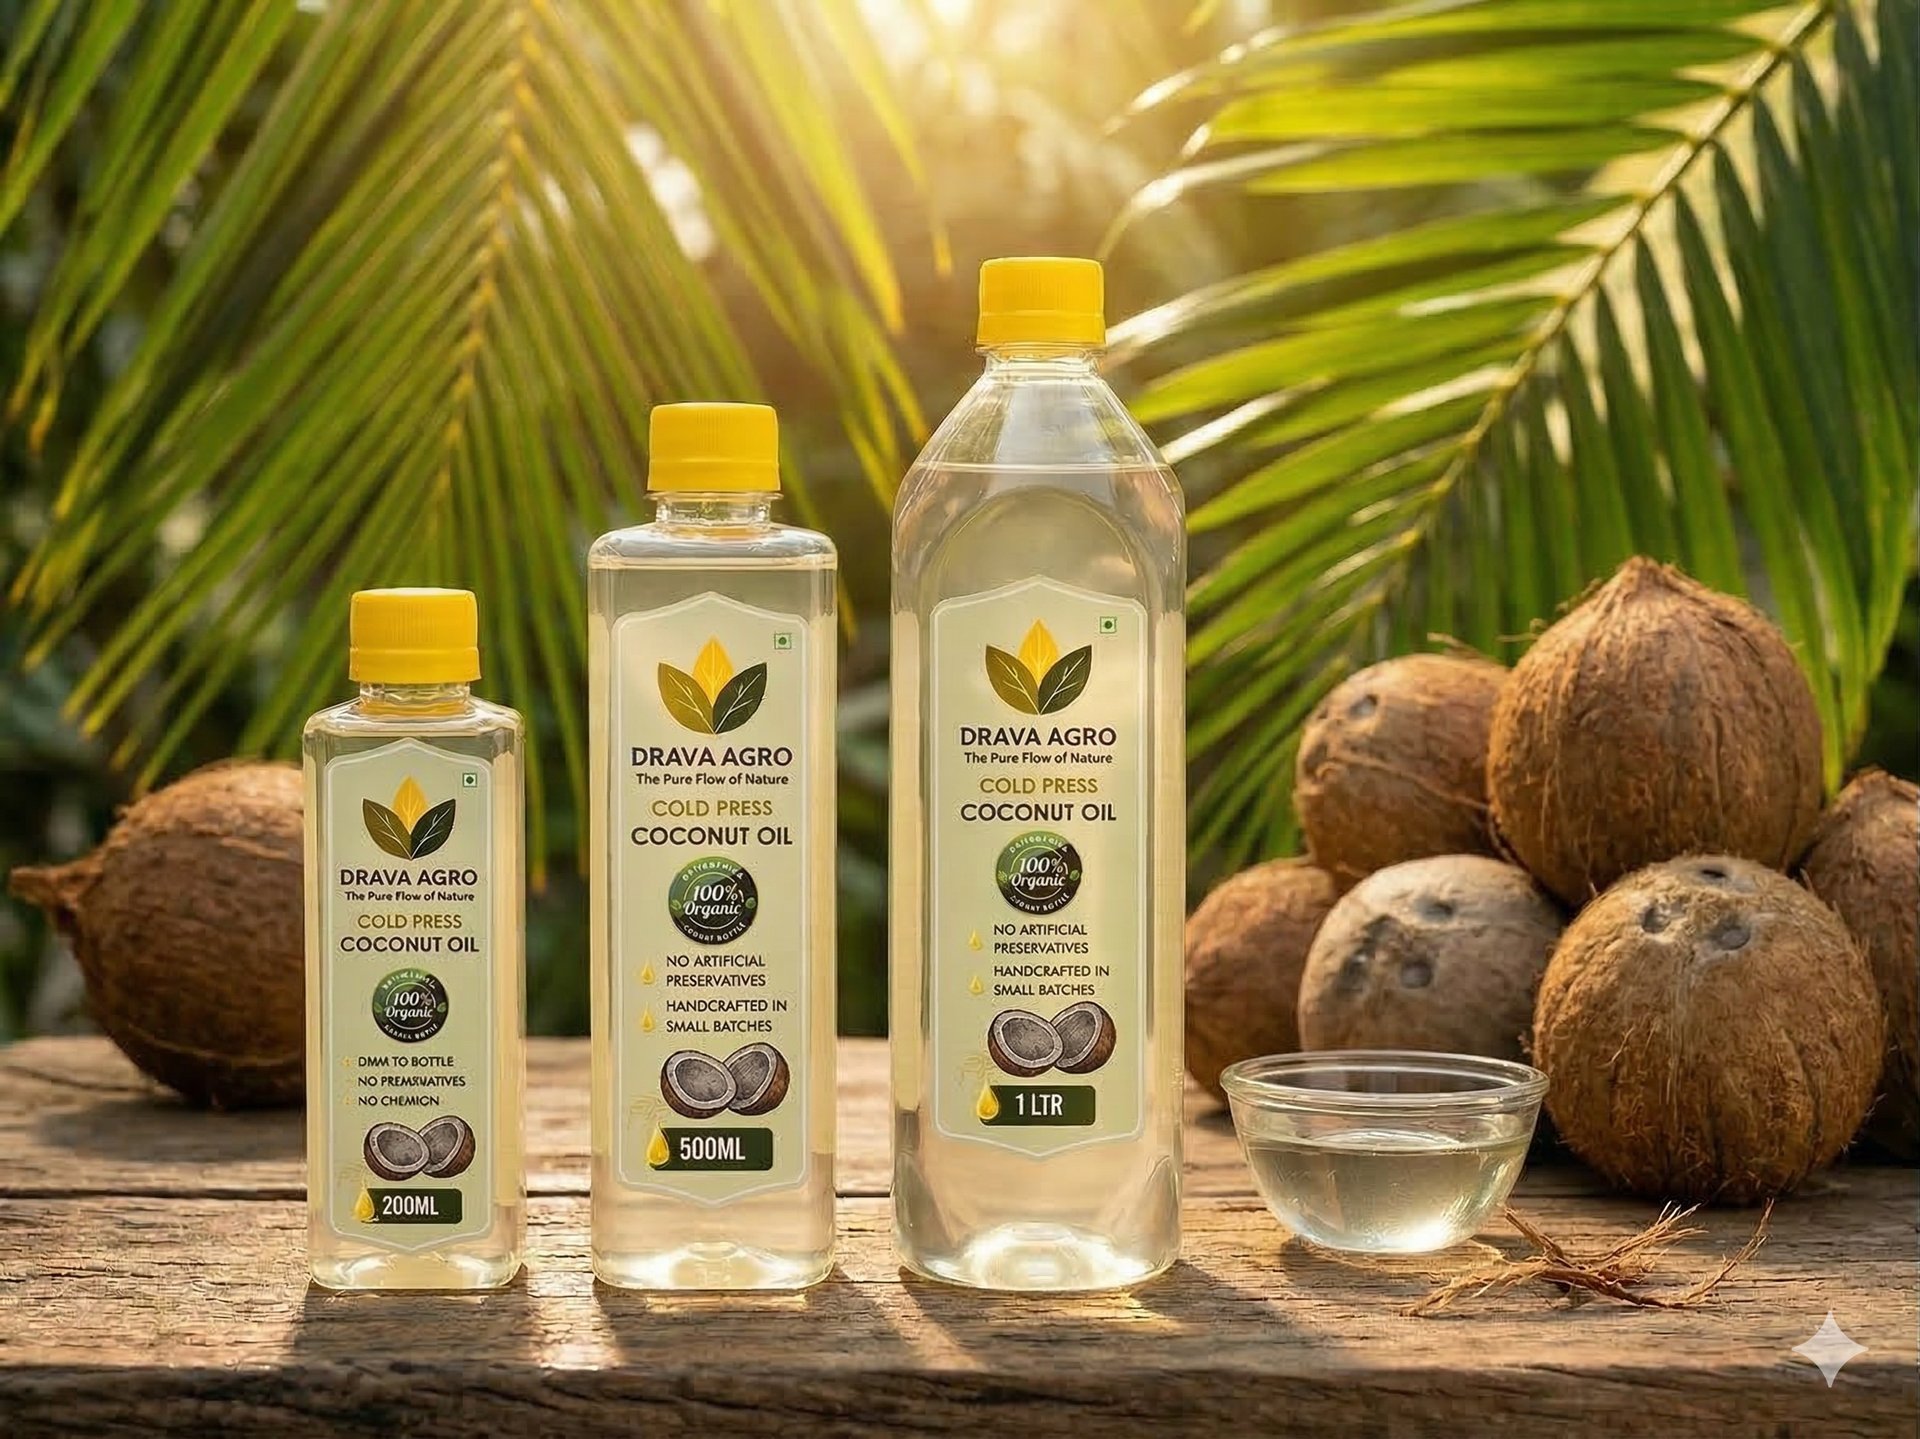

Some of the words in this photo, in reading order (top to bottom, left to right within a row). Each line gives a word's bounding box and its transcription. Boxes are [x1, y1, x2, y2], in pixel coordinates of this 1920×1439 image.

[960, 727, 1041, 746] DRAVA
[1047, 727, 1117, 746] AGRO
[631, 747, 716, 766] DRAVA
[721, 747, 793, 766] AGRO
[964, 752, 987, 764] The
[990, 752, 1019, 764] Pure
[1022, 752, 1051, 764] Flow
[1054, 752, 1067, 764] of
[1071, 752, 1113, 764] Nature
[636, 773, 660, 785] The
[664, 773, 692, 785] Pure
[696, 773, 726, 785] Flow
[729, 773, 743, 785] of
[745, 773, 789, 785] Nature
[980, 778, 1036, 794] COLD
[1042, 778, 1098, 794] PRESS
[652, 800, 709, 817] COLD
[717, 800, 773, 817] PRESS
[960, 803, 1074, 821] COCONUT
[1081, 803, 1117, 821] OIL
[631, 826, 749, 845] COCONUT
[757, 826, 793, 845] OIL
[1020, 856, 1063, 873] 100%
[340, 869, 412, 885] DRAVA
[417, 869, 478, 885] AGRO
[1009, 873, 1066, 890] Organic
[345, 891, 365, 901] The
[368, 891, 393, 901] Pure
[396, 891, 422, 901] Flow
[424, 891, 436, 901] of
[437, 891, 475, 901] Nature
[693, 882, 738, 901] 100%
[683, 901, 741, 919] Organic
[357, 914, 407, 929] COLD
[413, 914, 462, 929] PRESS
[994, 924, 1015, 936] NO
[1020, 924, 1087, 936] ARTIFICIAL
[340, 936, 442, 952] COCONUT
[447, 936, 480, 952] OIL
[994, 942, 1089, 954] PRESERVATIVES
[666, 955, 689, 967] NO
[693, 955, 766, 967] ARTIFICIAL
[994, 965, 1091, 977] HANDCRAFTED
[1095, 965, 1110, 977] IN
[666, 974, 766, 987] PRESERVATIVES
[994, 984, 1034, 996] SMALL
[1039, 984, 1095, 996] BATCHES
[393, 991, 433, 1006] 100%
[666, 1000, 768, 1012] HANDCRAFTED
[772, 1000, 787, 1012] IN
[384, 1006, 433, 1021] Organic
[666, 1020, 709, 1032] SMALL
[713, 1020, 772, 1032] BATCHES
[392, 1056, 409, 1067] TO
[411, 1056, 454, 1067] BOTTLE
[358, 1076, 378, 1087] NO
[358, 1096, 378, 1106] NO
[1015, 1094, 1024, 1116] 1
[1031, 1094, 1063, 1116] LTR
[680, 1137, 746, 1160] 500ML
[382, 1196, 439, 1215] 200ML
